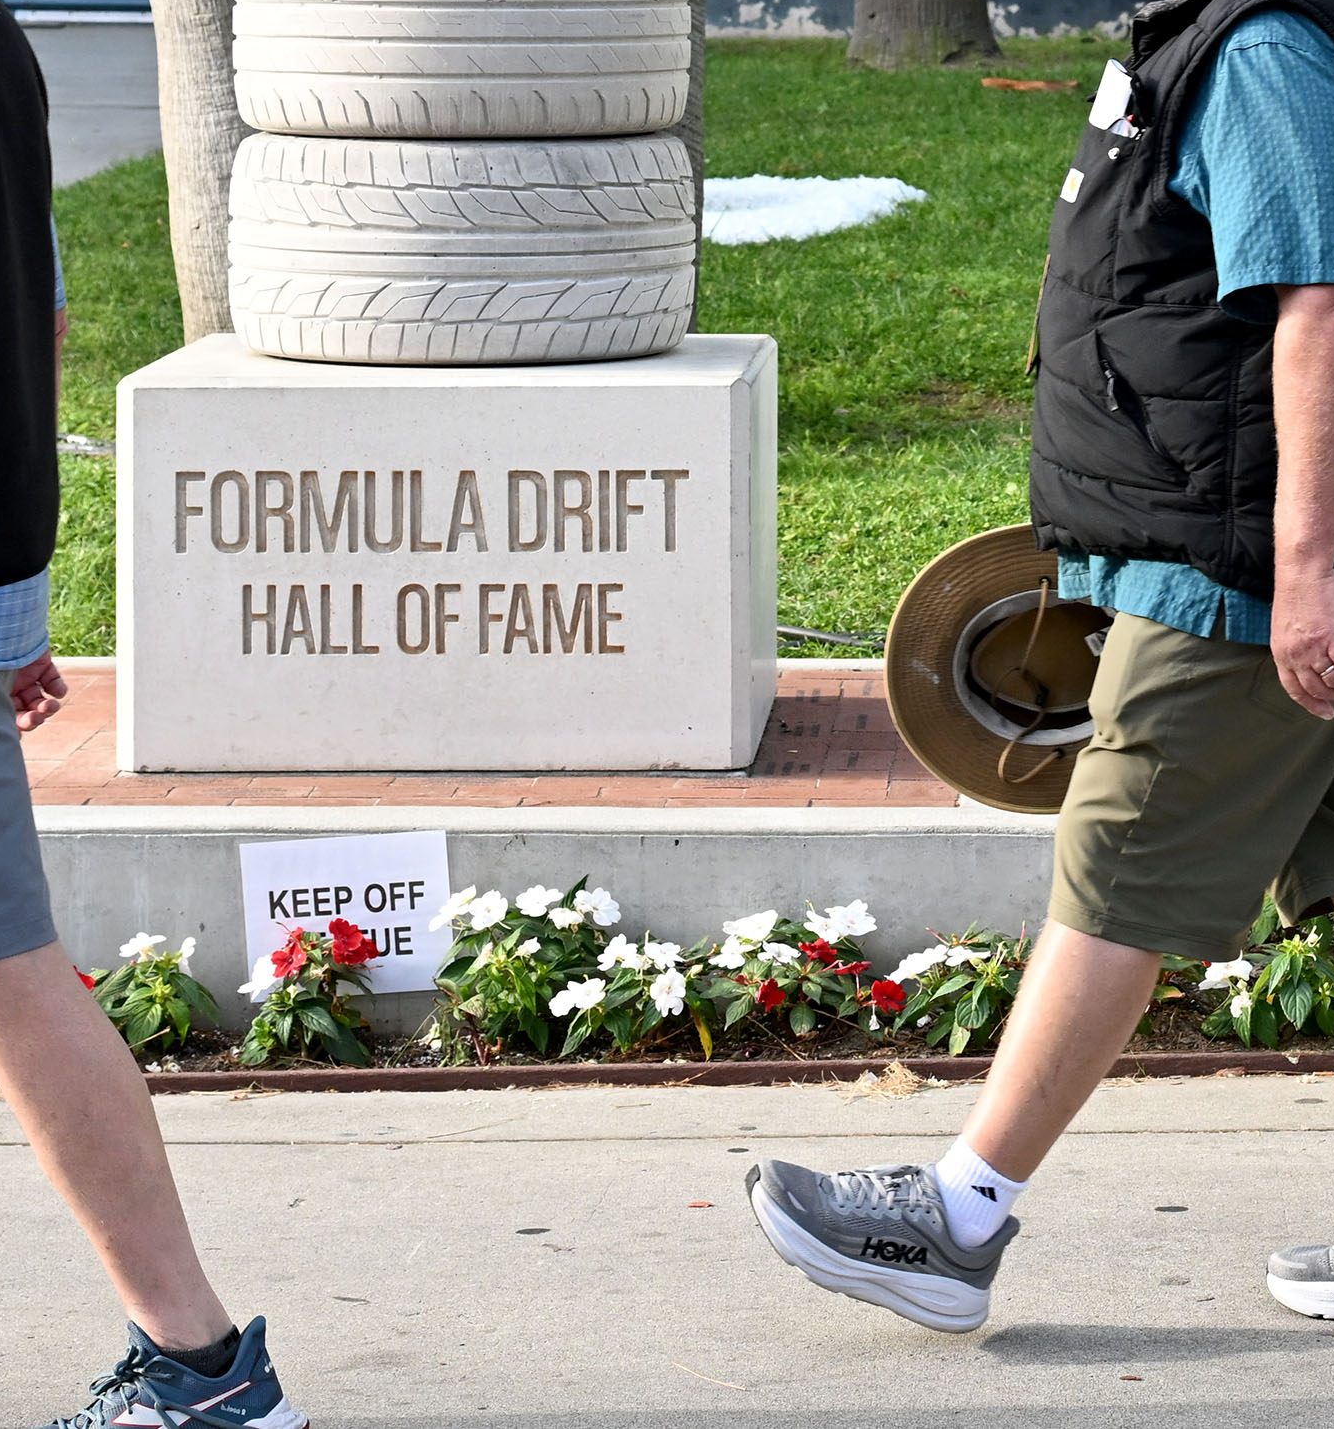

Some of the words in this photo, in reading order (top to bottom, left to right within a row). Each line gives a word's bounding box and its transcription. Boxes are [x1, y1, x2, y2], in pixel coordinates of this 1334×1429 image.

[173, 469, 489, 554] FORMULA
[506, 468, 690, 553] DRIFT
[240, 583, 380, 655] HALL
[394, 582, 462, 655] OF
[477, 582, 626, 655] FAME
[268, 886, 353, 919] KEEP
[363, 880, 425, 913] OFF
[860, 1236, 928, 1266] HOKA
